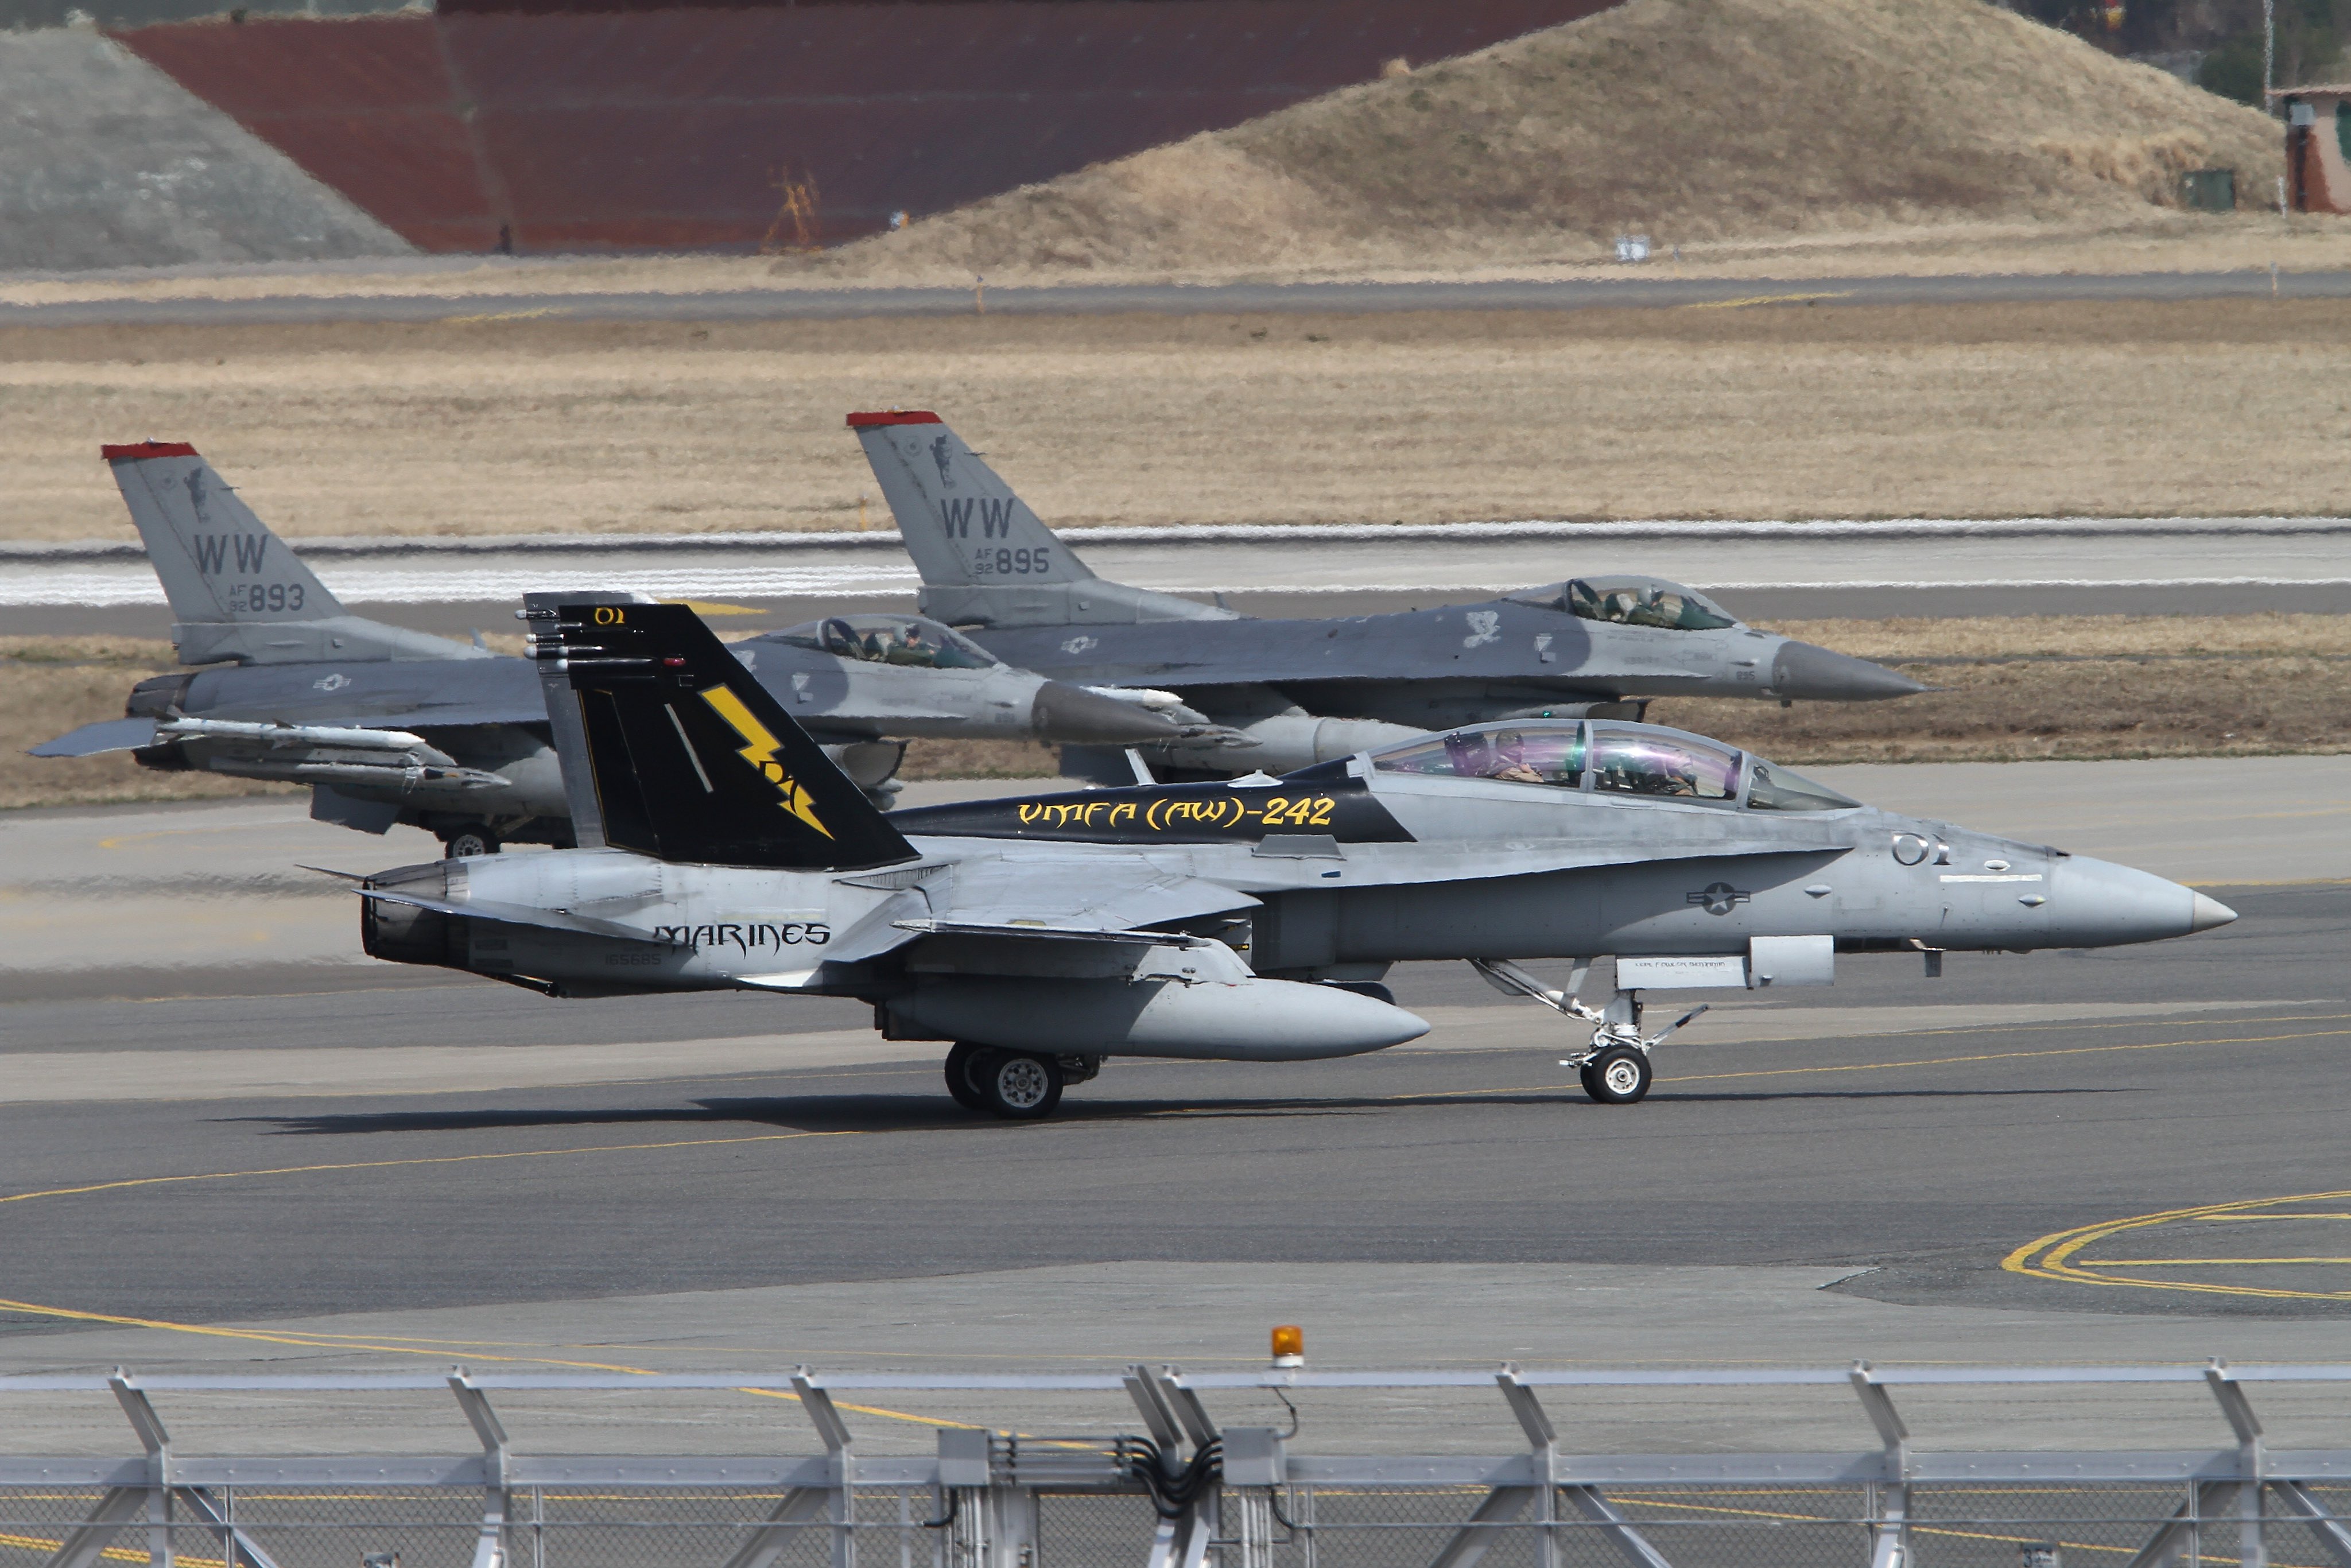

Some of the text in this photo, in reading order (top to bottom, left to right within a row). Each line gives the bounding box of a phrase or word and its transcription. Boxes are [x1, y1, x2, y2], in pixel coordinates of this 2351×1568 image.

[940, 498, 1014, 538] WW
[194, 534, 268, 574] WW
[976, 548, 993, 559] AF
[996, 547, 1050, 574] 895
[975, 563, 994, 574] 92
[230, 584, 247, 596] AF
[249, 583, 304, 612] 893
[1018, 802, 1137, 828] VMFA
[653, 923, 831, 960] MARINES
